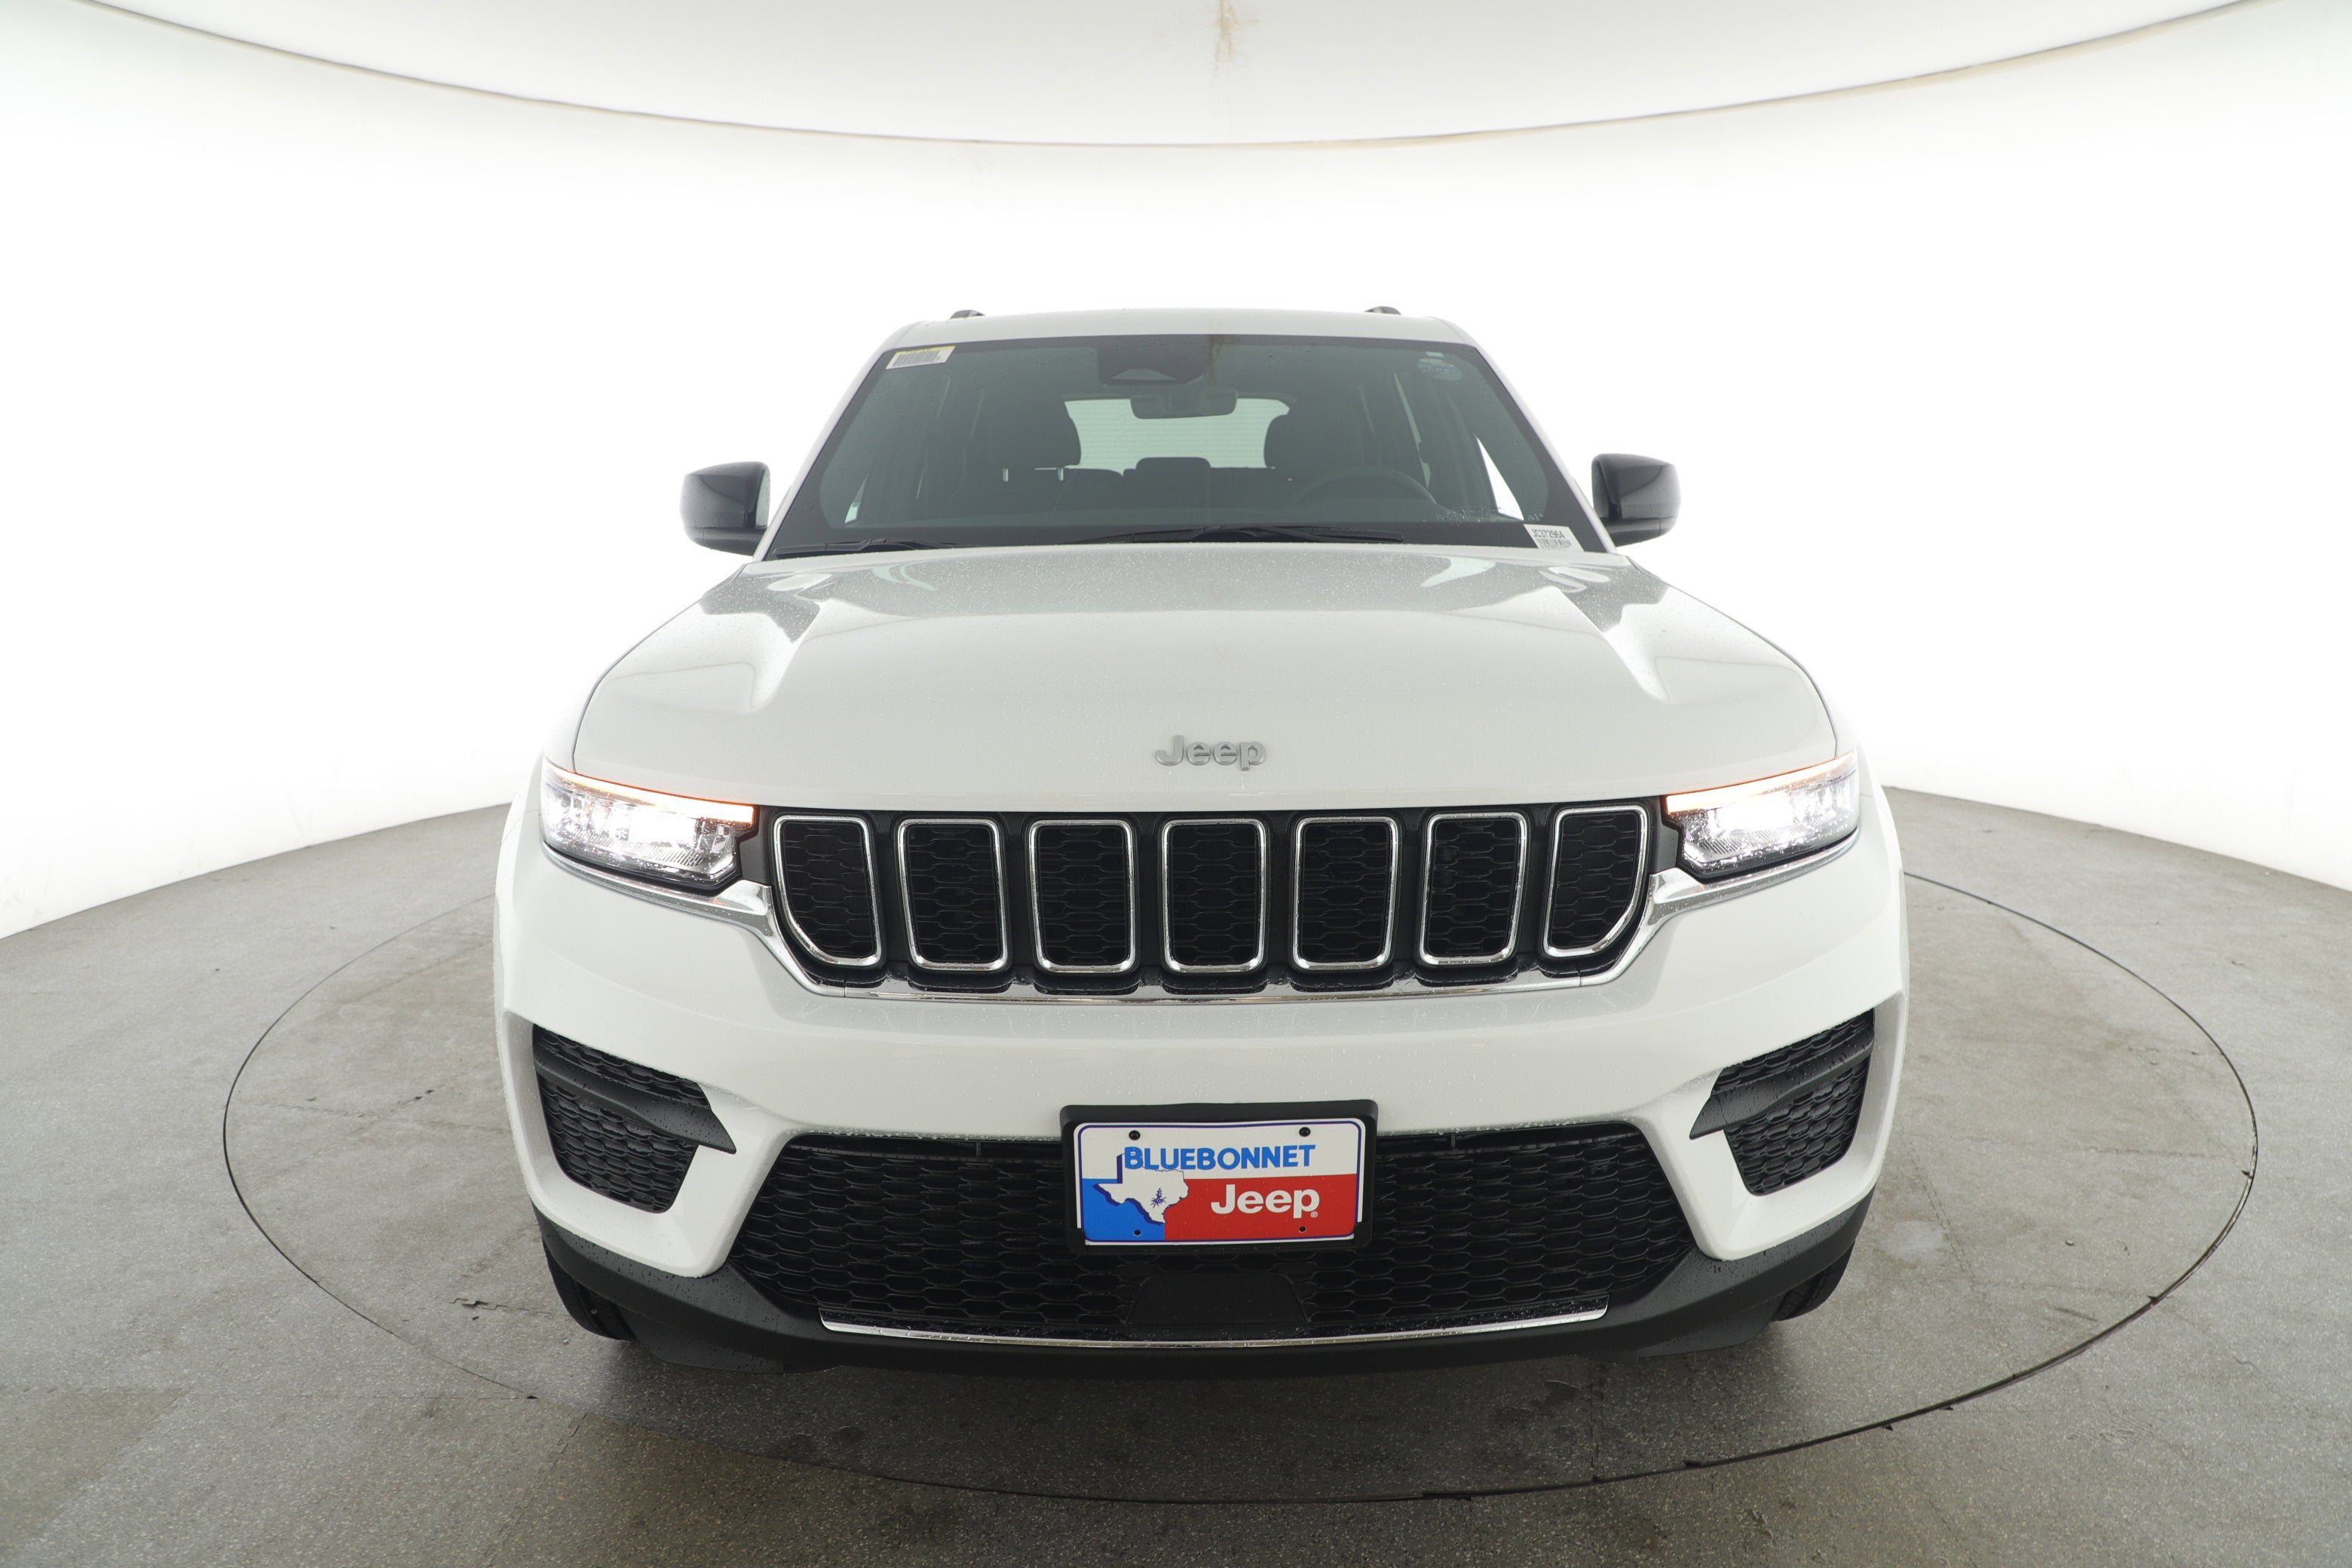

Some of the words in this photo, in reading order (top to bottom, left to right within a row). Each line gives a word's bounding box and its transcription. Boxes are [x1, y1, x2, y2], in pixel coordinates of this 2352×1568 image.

[1155, 734, 1266, 771] Jeep
[1124, 1144, 1316, 1170] BLUEBONNET
[1211, 1184, 1320, 1219] Jeep
